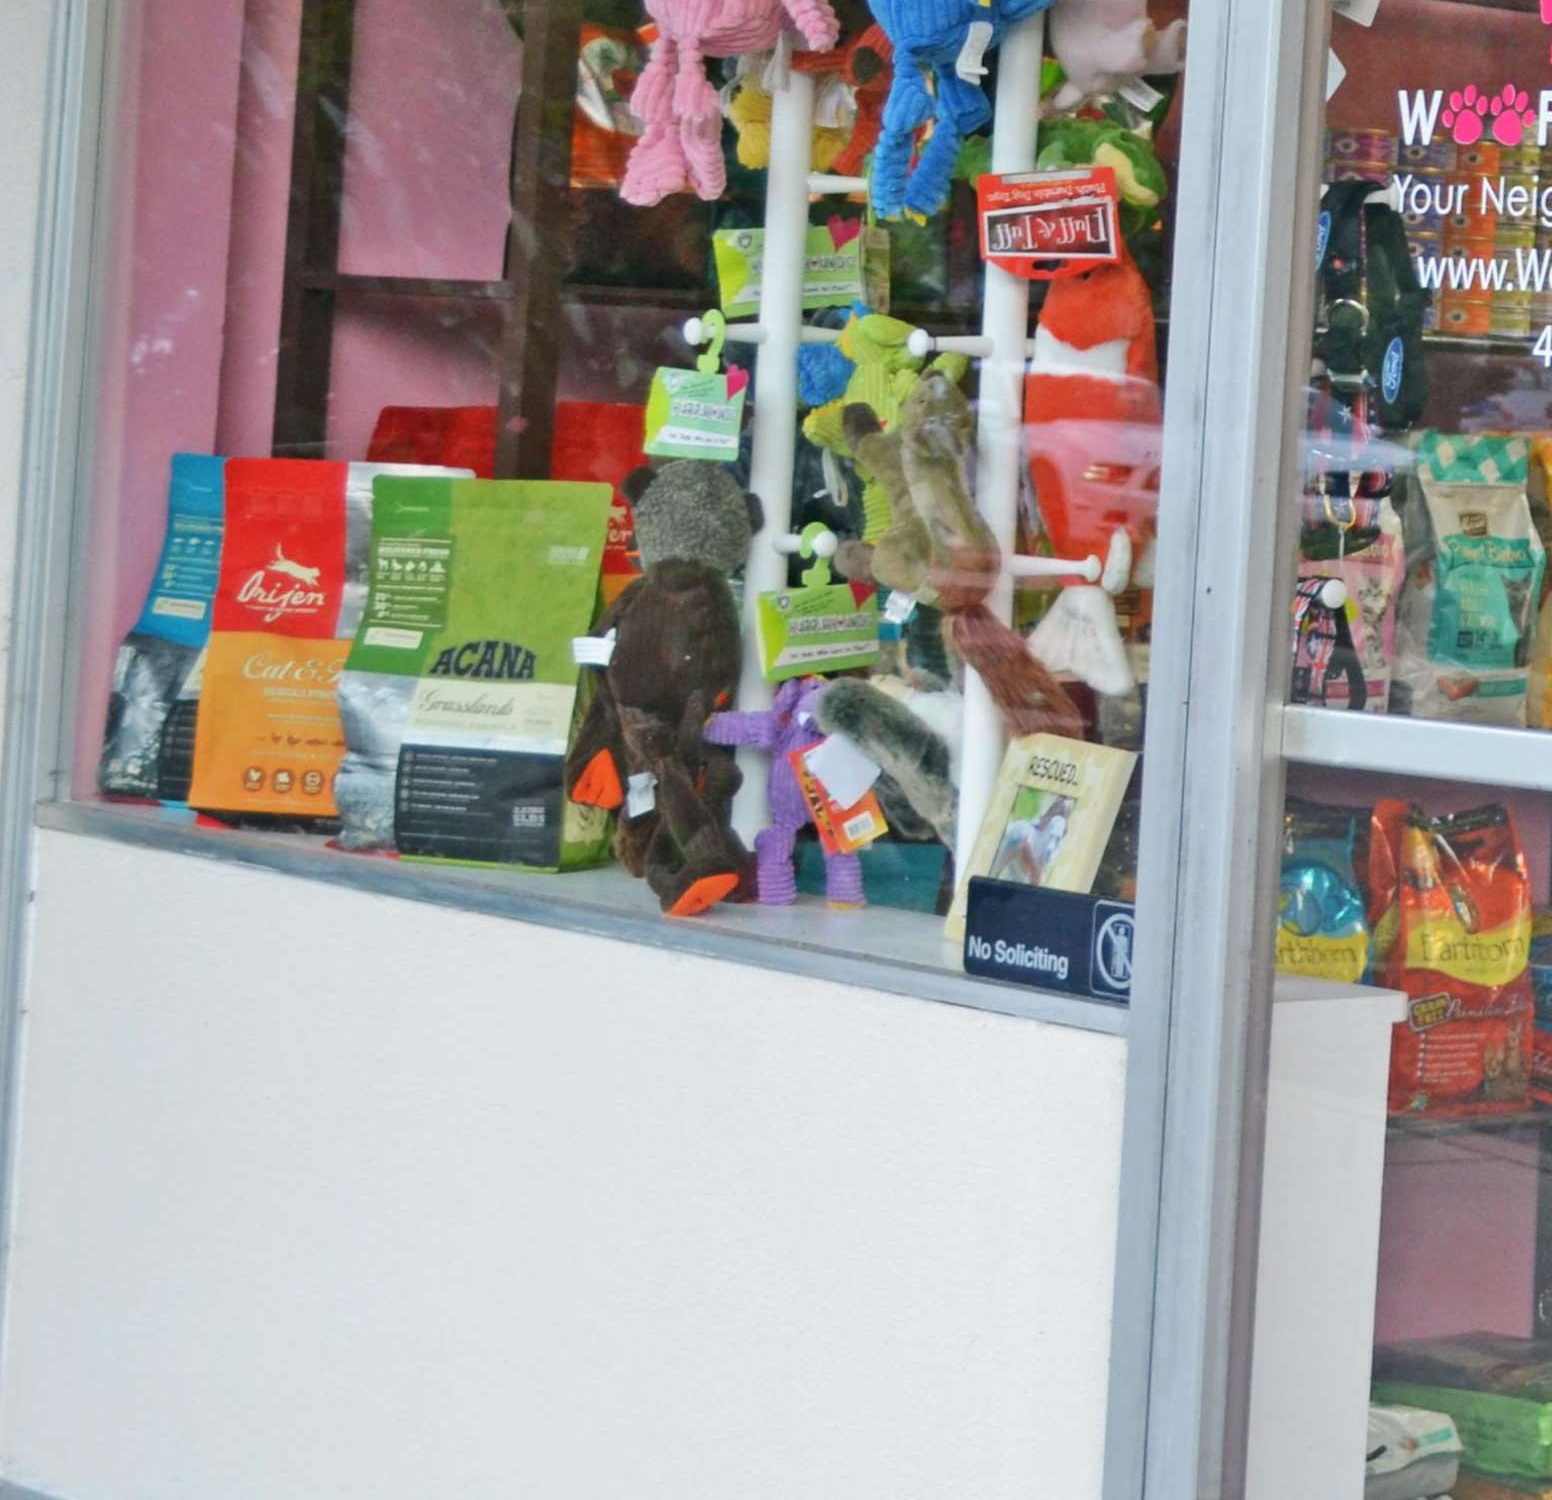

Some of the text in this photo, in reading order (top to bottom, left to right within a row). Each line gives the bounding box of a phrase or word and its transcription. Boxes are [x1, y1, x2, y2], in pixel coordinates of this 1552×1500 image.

[1391, 175, 1467, 217] Your
[992, 214, 1038, 251] Tuff
[1056, 206, 1107, 244] Fluff
[236, 570, 326, 623] Orijen
[429, 639, 537, 679] ACANA
[968, 934, 1070, 981] No Soliciting
